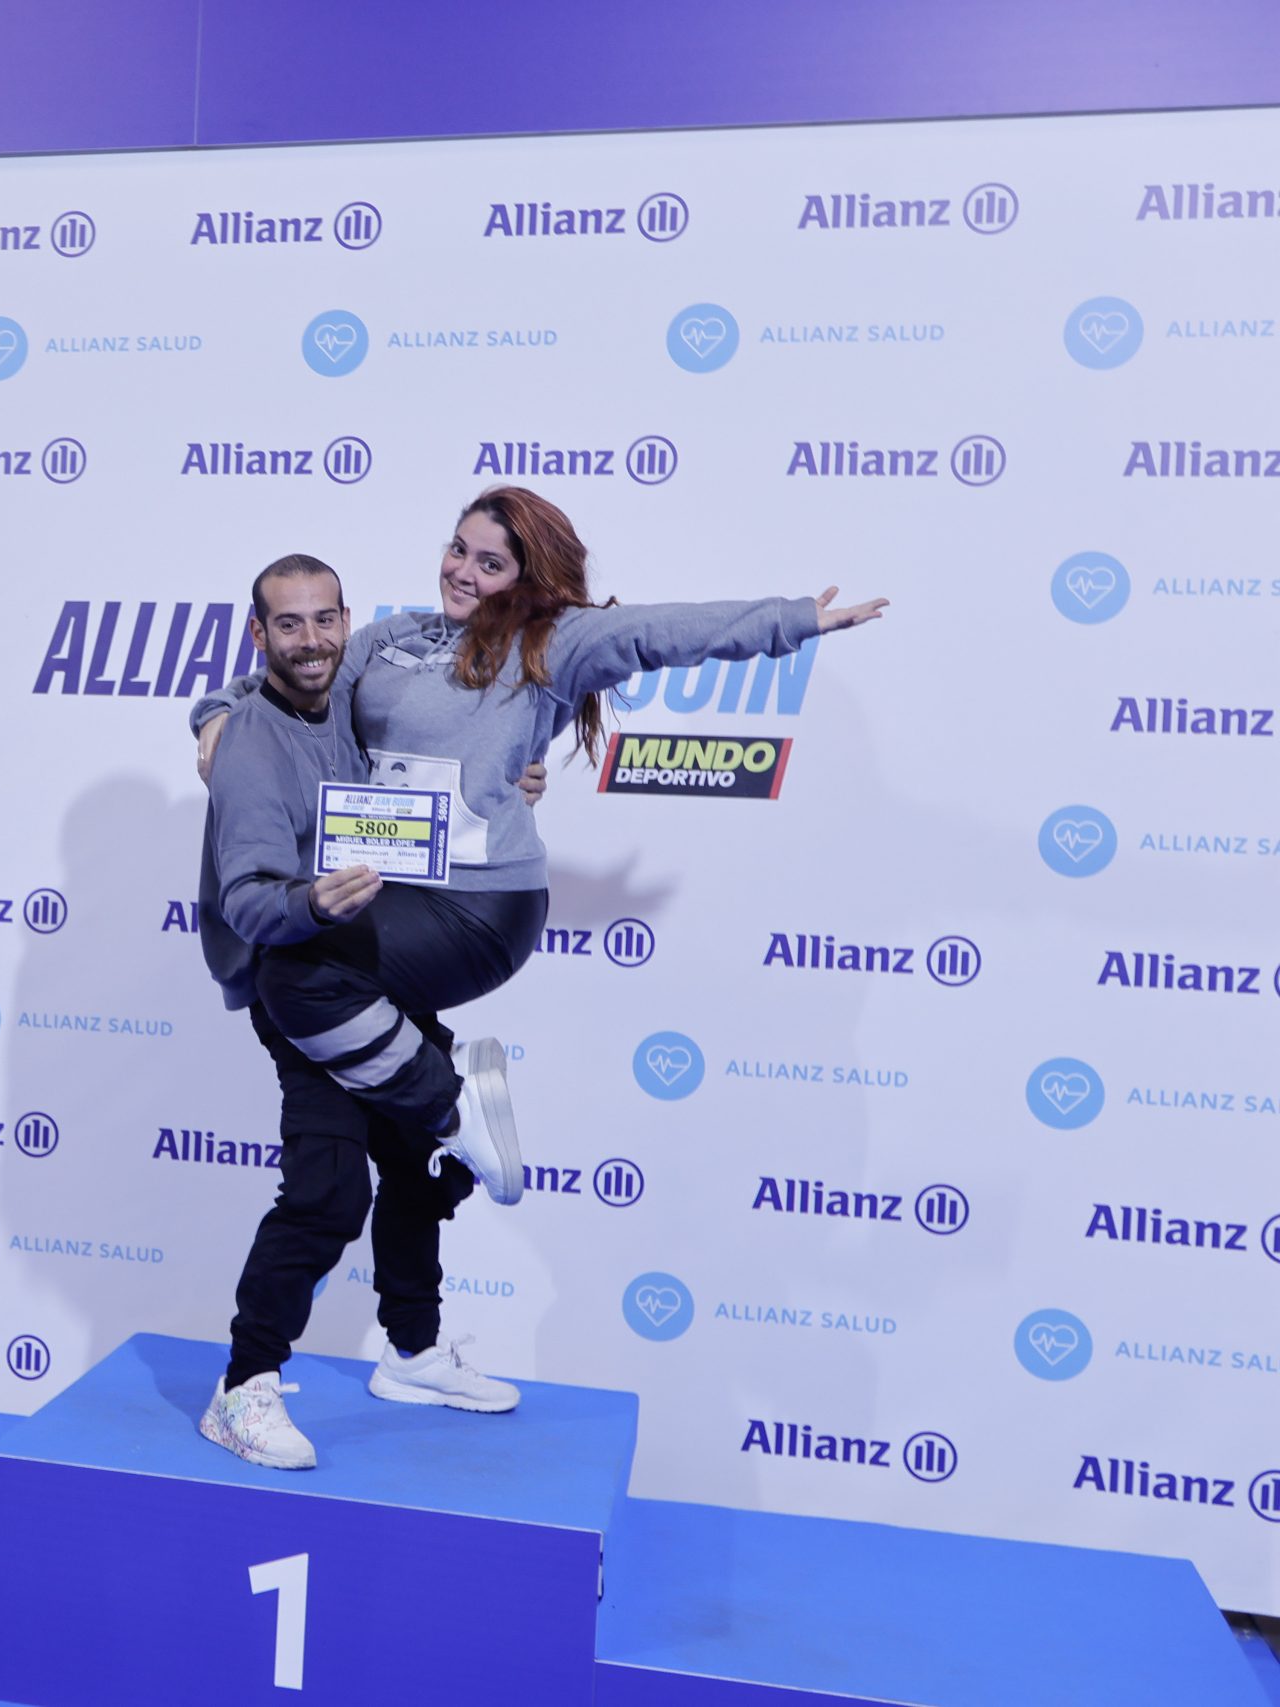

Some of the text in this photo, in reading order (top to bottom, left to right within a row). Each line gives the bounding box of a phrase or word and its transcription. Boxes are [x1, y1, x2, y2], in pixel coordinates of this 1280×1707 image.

[798, 194, 950, 229] Allianz
[1136, 183, 1280, 220] Allian
[191, 212, 322, 244] Allianz
[484, 202, 625, 237] Allianz
[45, 336, 202, 352] ALLIANZ SALUD
[388, 330, 557, 347] ALLIANZ SALUD
[760, 325, 944, 343] ALLIANZ SALUD
[1167, 320, 1274, 337] ALLIANZ
[181, 443, 312, 474] Allianz
[473, 442, 614, 475] Allianz
[787, 442, 938, 476] Allianz
[1123, 441, 1280, 477] Allianz
[1153, 578, 1261, 596] ALLIANZ
[1110, 697, 1273, 736] Allianz
[619, 737, 776, 773] MUNDO
[615, 767, 736, 787] DEPORTIVO
[438, 795, 449, 823] 5800
[355, 820, 398, 836] 5800
[1140, 834, 1247, 854] ALLIANZ
[763, 933, 913, 973] Allianz
[1098, 951, 1260, 994] Allianz
[18, 1012, 173, 1036] ALLIANZ SALUD
[726, 1060, 908, 1087] ALLIANZ SALUD
[1127, 1088, 1234, 1110] ALLIANZ
[152, 1127, 282, 1169] Allianz
[752, 1177, 902, 1221] Allianz
[1085, 1204, 1247, 1250] Allianz
[10, 1235, 164, 1264] ALLIANZ SALUD
[446, 1276, 514, 1297] SALUD
[715, 1302, 896, 1334] ALLIANZ SALUD
[1115, 1341, 1280, 1372] ALLIANZ SAL
[741, 1420, 890, 1467] Allianz
[1073, 1456, 1234, 1507] Allianz
[248, 1553, 309, 1690] 1
